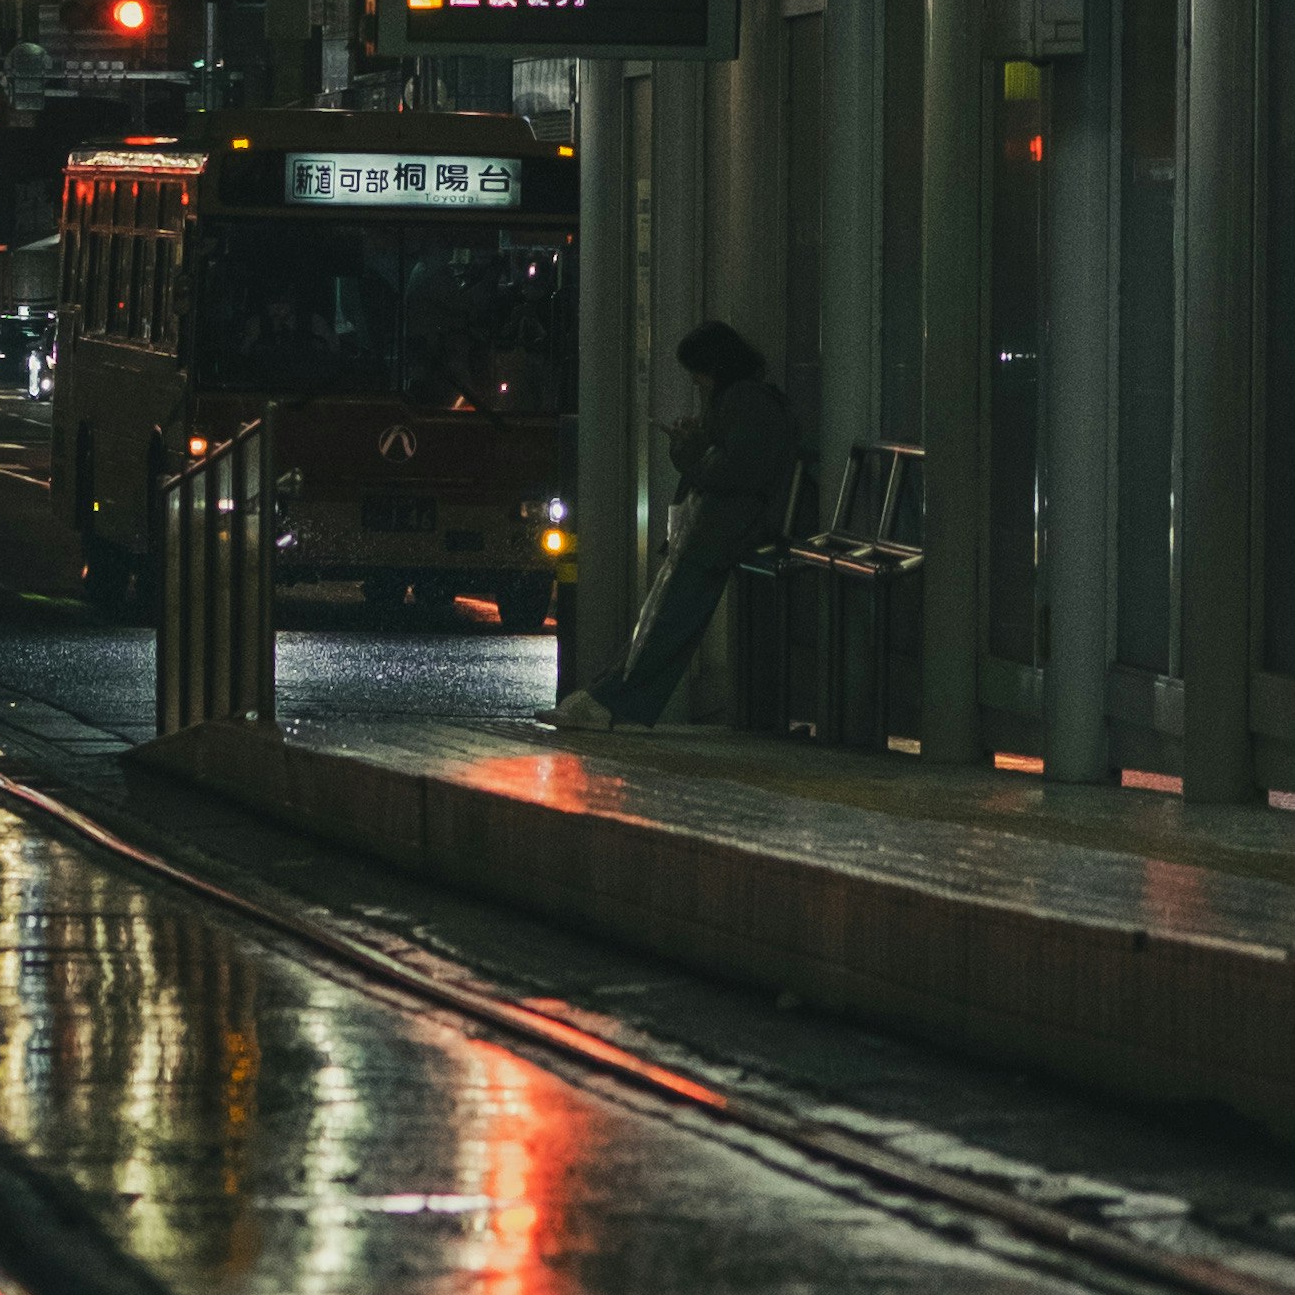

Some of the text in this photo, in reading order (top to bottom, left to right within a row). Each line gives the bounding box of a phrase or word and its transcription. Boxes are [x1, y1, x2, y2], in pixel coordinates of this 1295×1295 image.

[295, 162, 512, 195] 新道 可部 桐陽台
